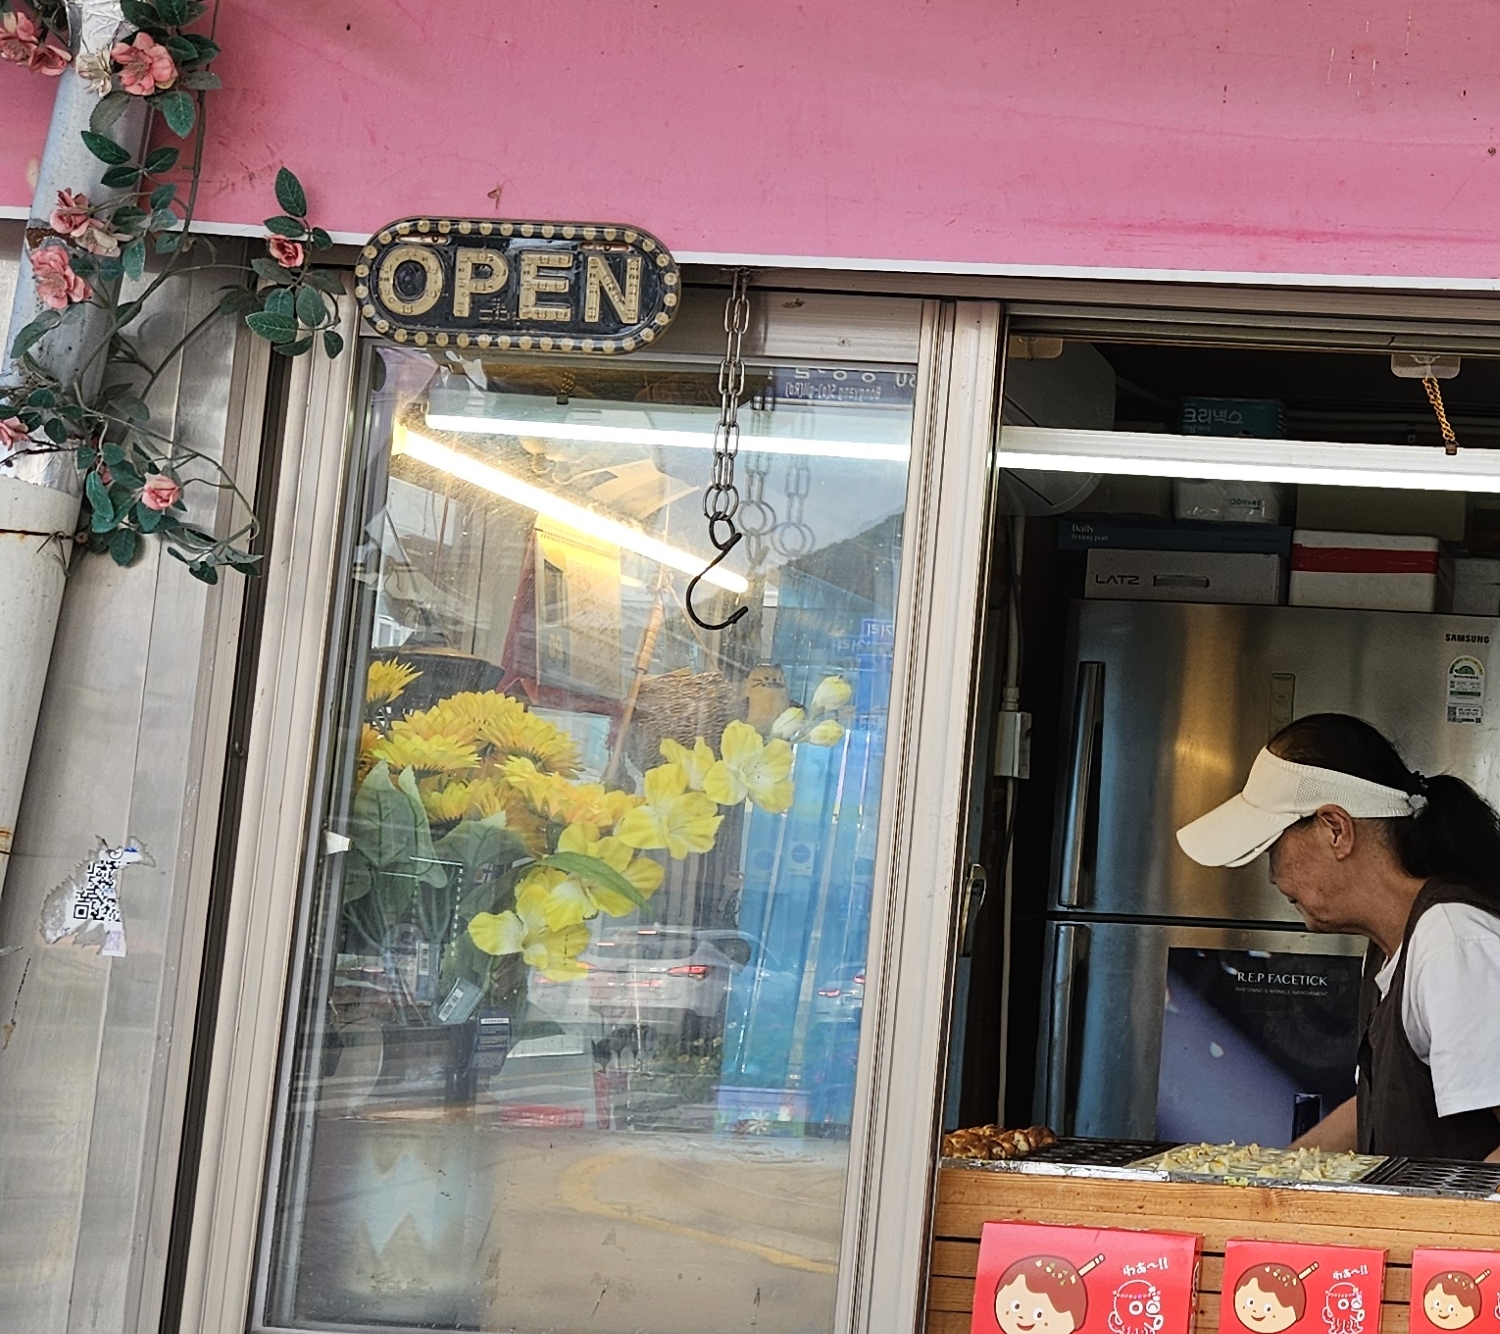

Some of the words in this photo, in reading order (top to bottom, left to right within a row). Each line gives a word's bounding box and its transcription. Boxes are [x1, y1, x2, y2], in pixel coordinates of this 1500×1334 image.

[378, 247, 644, 323] OPEN
[1445, 633, 1489, 644] SAMSUNG
[1237, 972, 1265, 983] R.E.P
[1267, 973, 1328, 986] FACETICK
